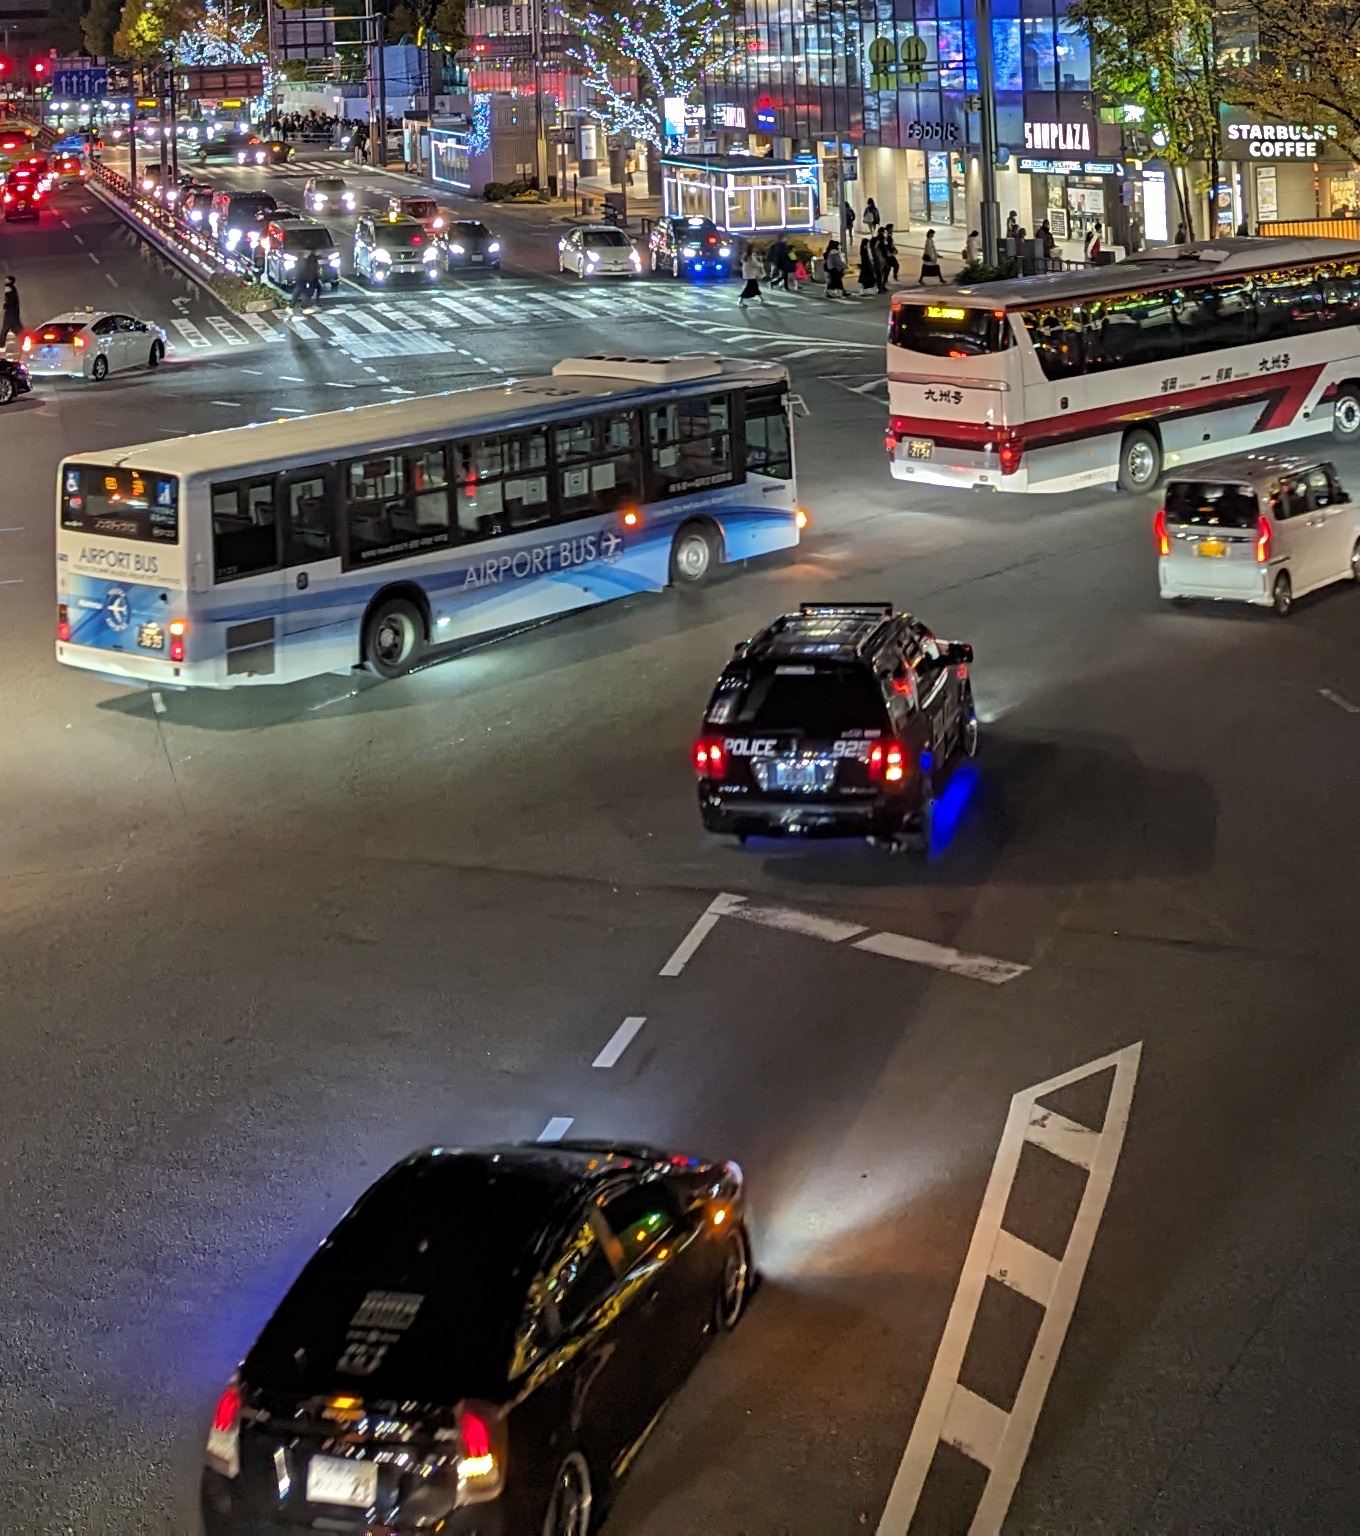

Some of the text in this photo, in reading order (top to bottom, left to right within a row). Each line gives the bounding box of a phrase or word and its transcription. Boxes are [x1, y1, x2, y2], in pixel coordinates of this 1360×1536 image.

[1024, 122, 1091, 151] SUNPLAZA
[1228, 124, 1338, 141] STARBUCKS
[1249, 141, 1317, 157] COFFEE
[1258, 353, 1291, 372] 九州号
[924, 389, 963, 404] 九州号
[79, 547, 158, 573] AIRPORT BUS
[463, 545, 555, 590] AIRPORT
[560, 536, 596, 566] BUS
[724, 738, 778, 756] POLICE
